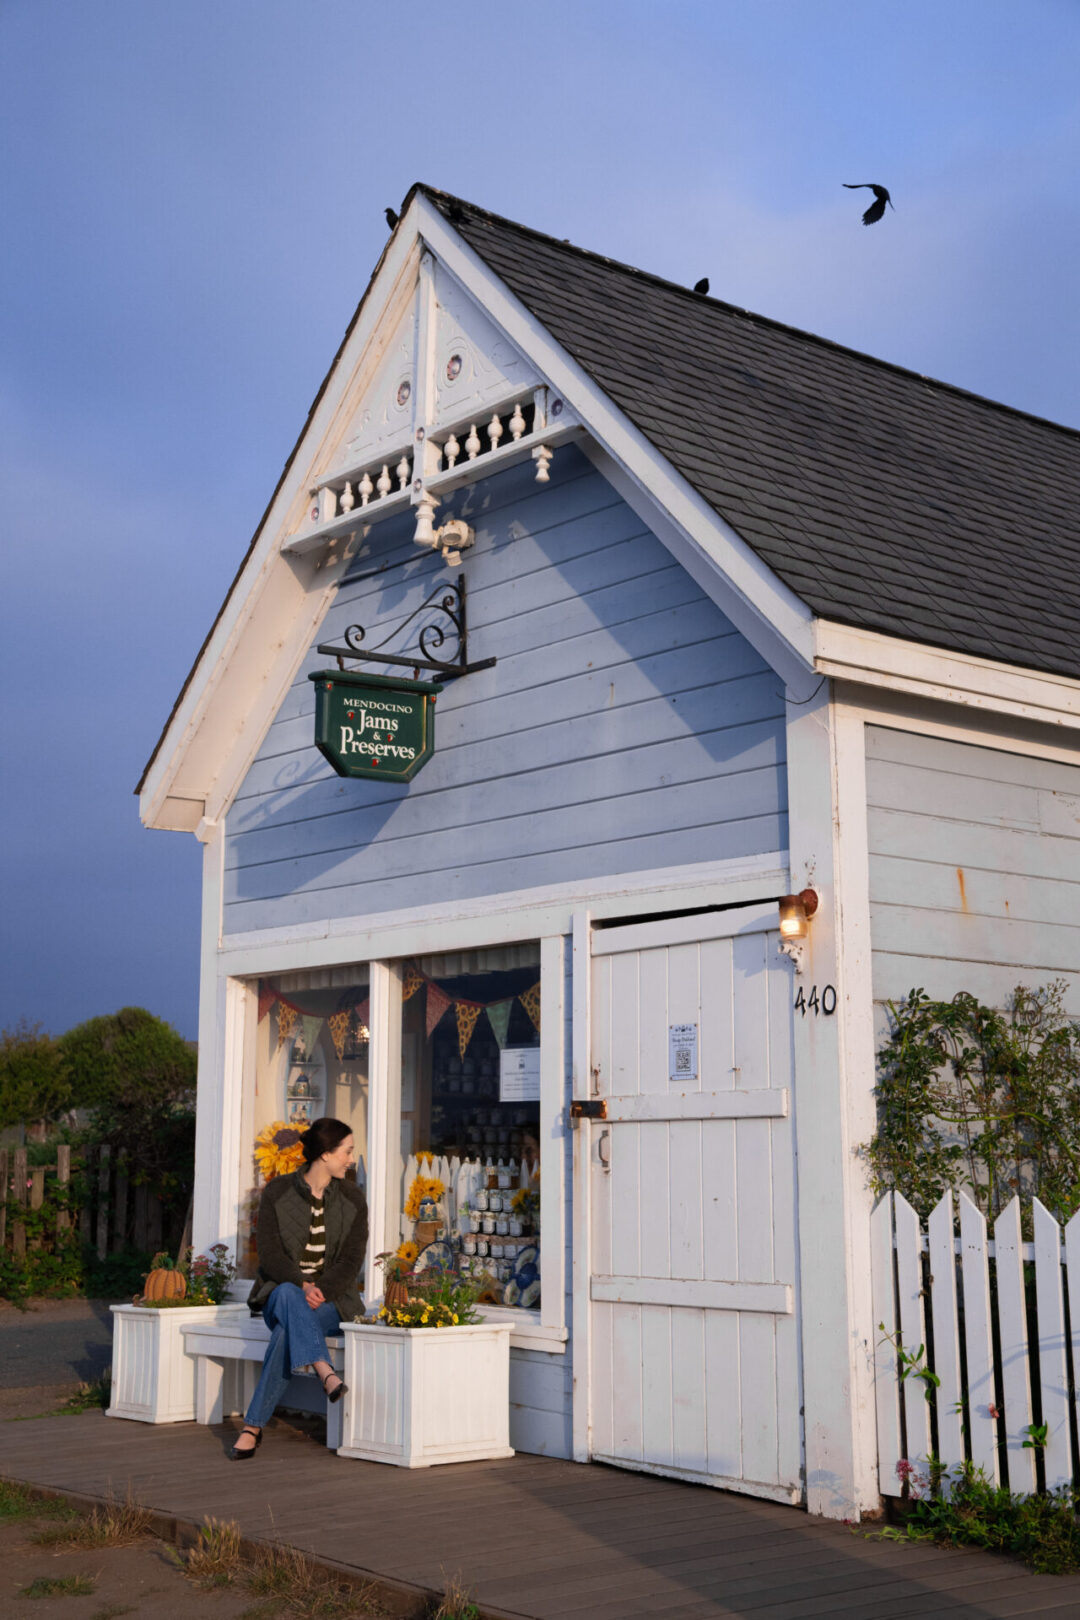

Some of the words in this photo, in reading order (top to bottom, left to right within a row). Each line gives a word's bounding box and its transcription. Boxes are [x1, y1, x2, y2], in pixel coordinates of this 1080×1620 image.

[343, 698, 413, 714] MENDOCINO
[357, 709, 399, 735] Jams
[340, 726, 415, 759] Preserves
[373, 732, 381, 741] &
[794, 984, 837, 1017] 440
